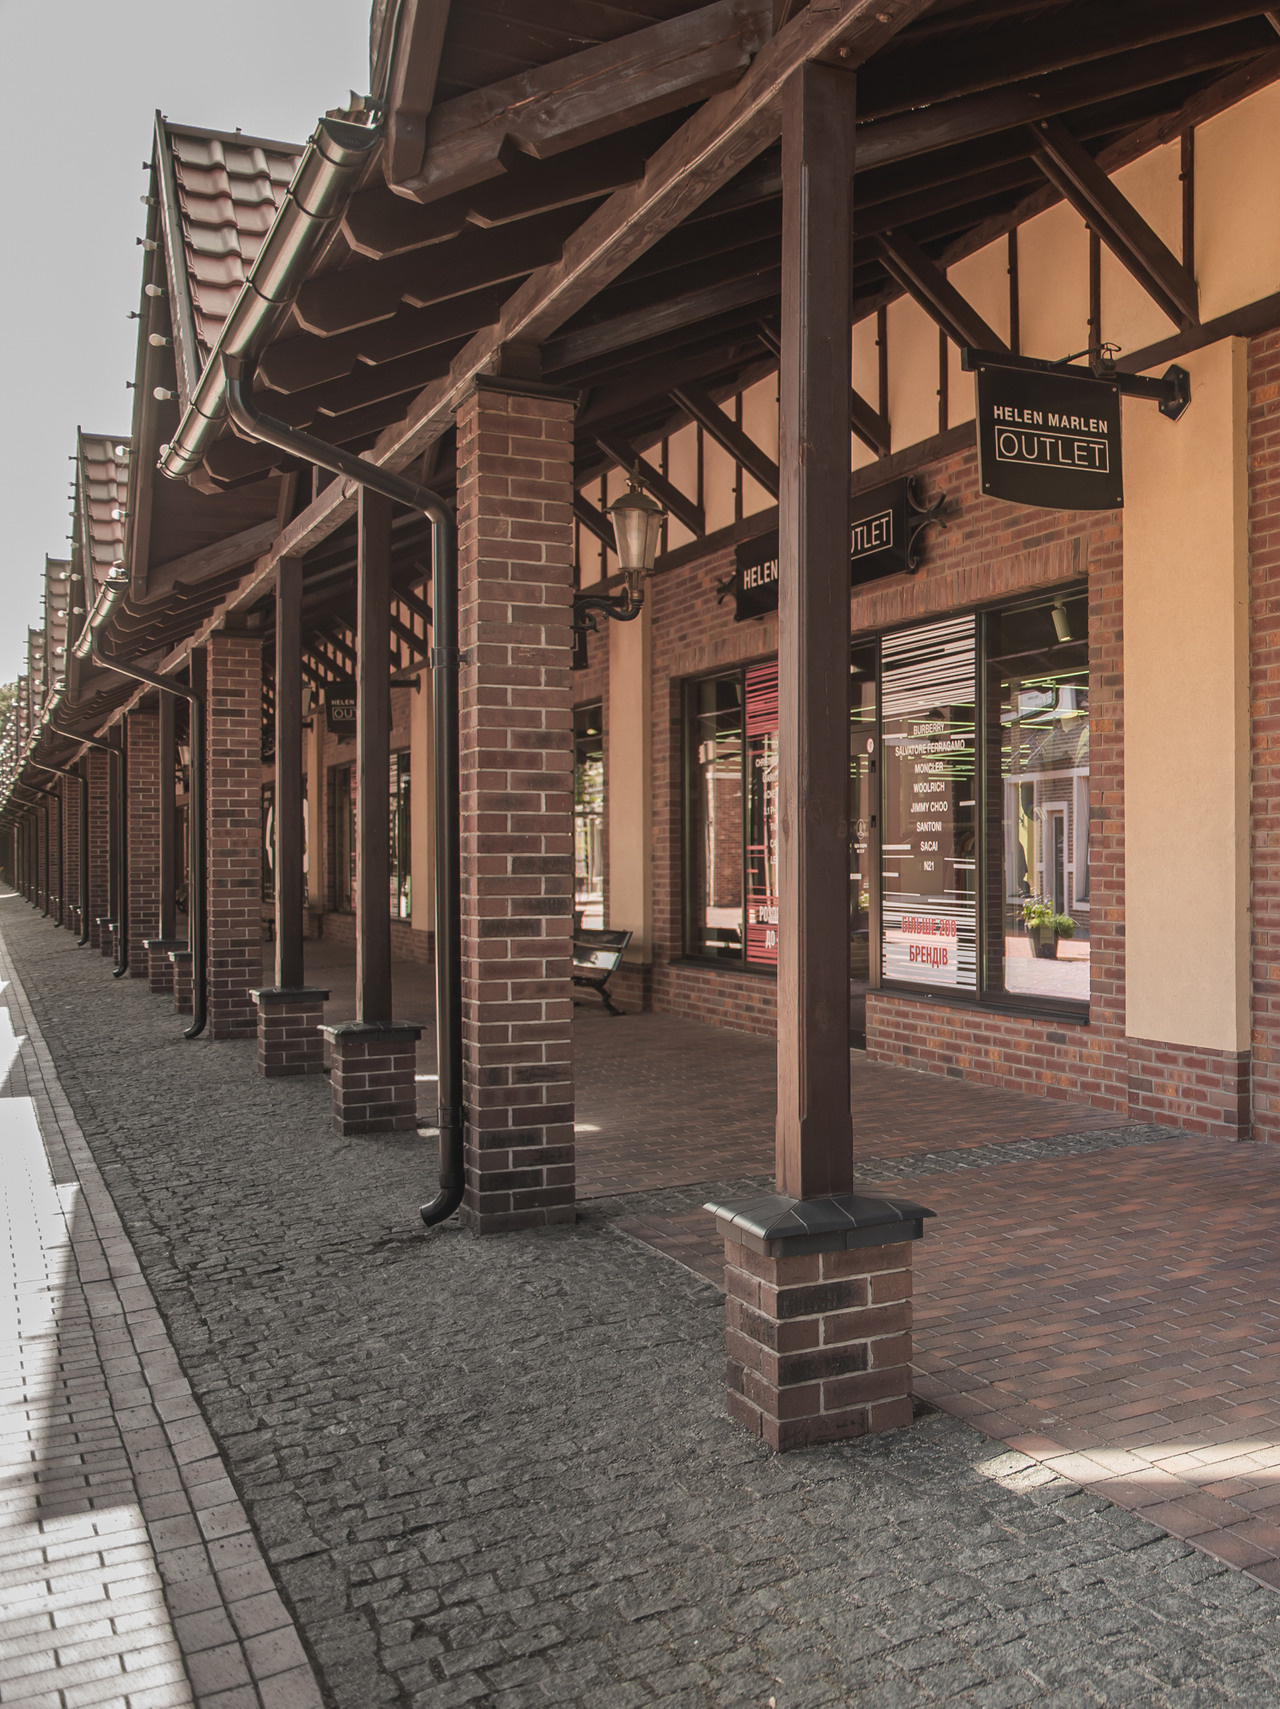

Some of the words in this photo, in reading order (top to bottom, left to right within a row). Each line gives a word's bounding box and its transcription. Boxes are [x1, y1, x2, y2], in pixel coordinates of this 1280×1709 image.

[993, 405, 1043, 425] HELEN
[1048, 412, 1108, 434] MARLEN
[1000, 432, 1104, 467] OUTLET
[743, 558, 778, 590] HELEN
[913, 722, 945, 735] BURBERRY
[895, 744, 927, 757] SALVATORE
[927, 739, 966, 753] FERRAGAMO
[914, 761, 944, 774] MONCLER
[913, 781, 945, 794] WOOLRICH
[910, 802, 930, 813] JIMMY
[930, 801, 949, 812] CHOO
[916, 821, 942, 832] SANTONI
[920, 841, 938, 852] SACAI
[923, 860, 935, 871] N21
[902, 915, 936, 936] БІЛЬШЕ
[939, 919, 957, 937] 200
[909, 944, 949, 969] БРЕНДІВ
